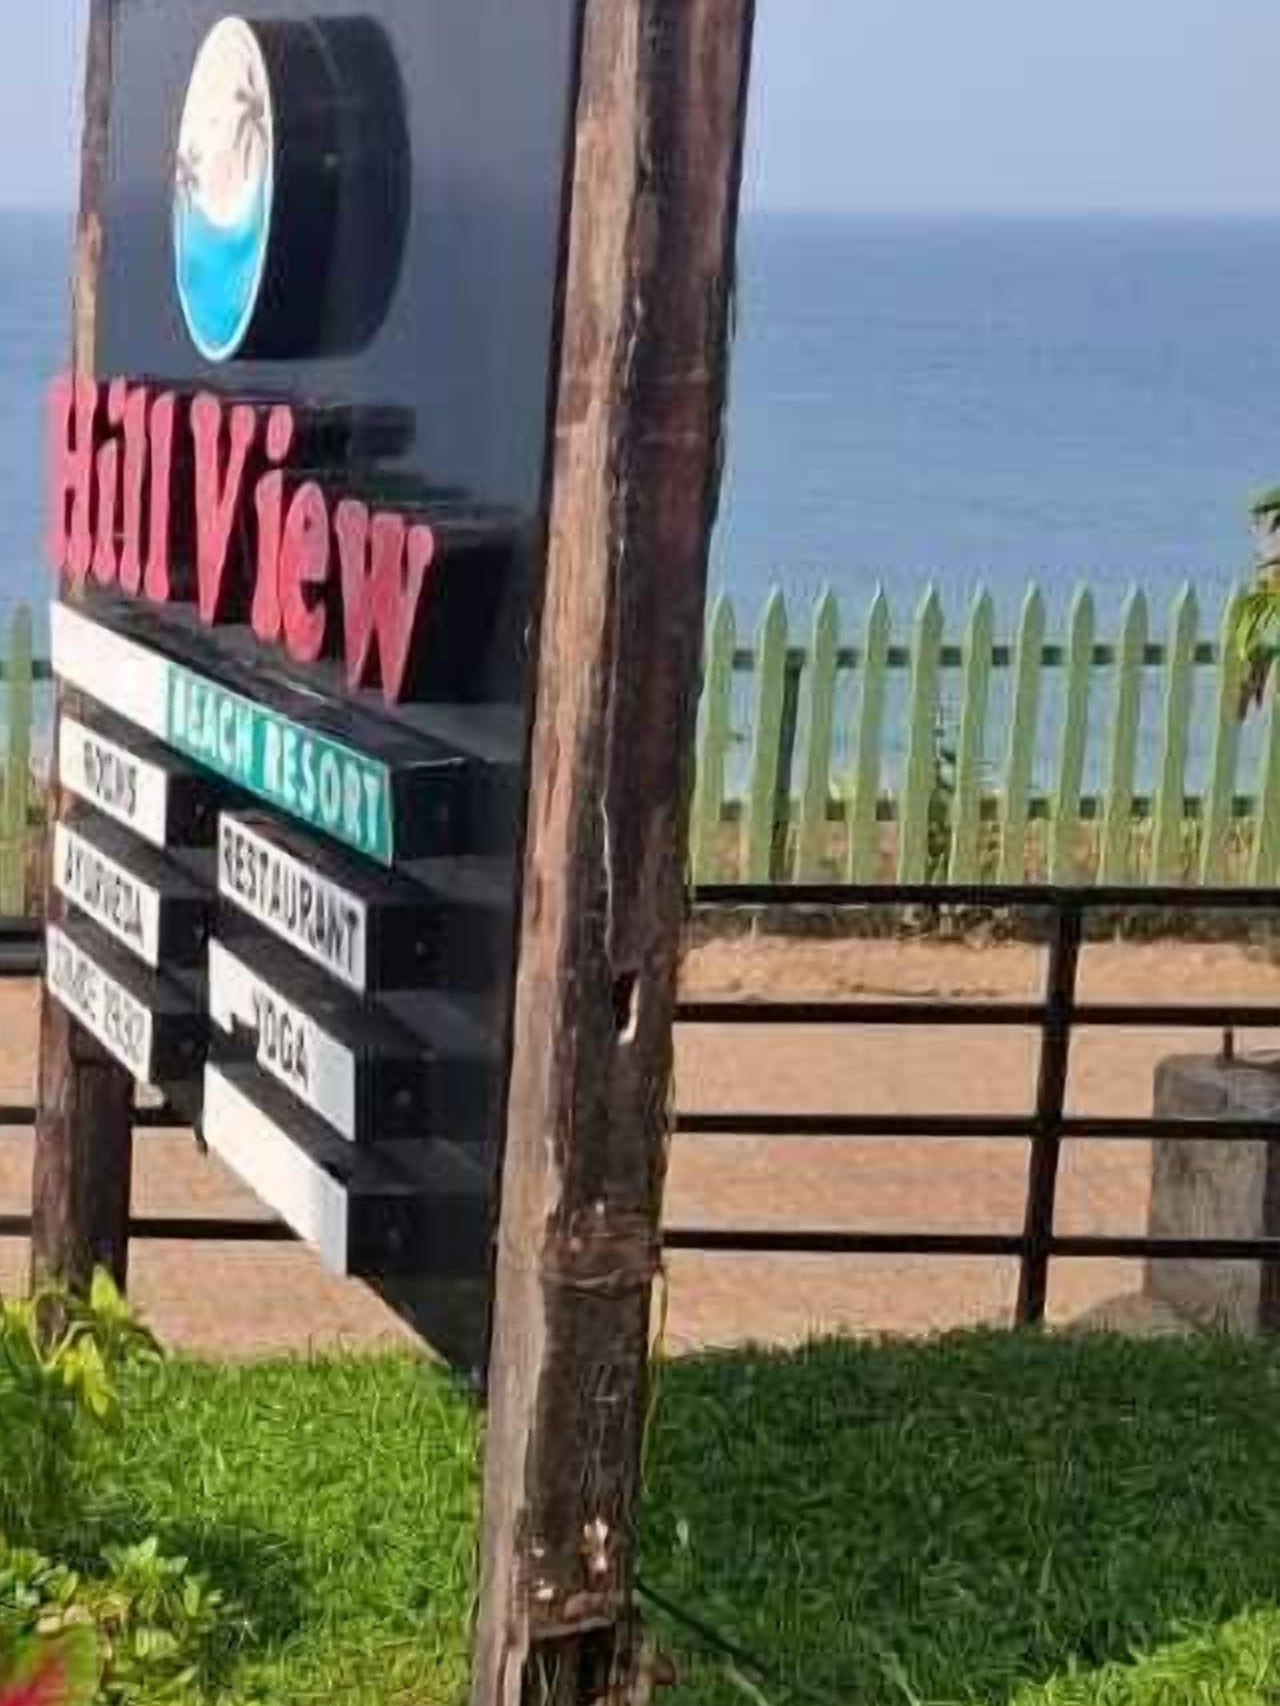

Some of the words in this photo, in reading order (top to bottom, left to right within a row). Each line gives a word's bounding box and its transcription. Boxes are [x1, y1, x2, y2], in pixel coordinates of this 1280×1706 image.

[46, 374, 176, 601] Hill
[191, 391, 434, 711] View
[263, 721, 382, 851] RESORT
[222, 823, 358, 973] RESTAURANT
[252, 983, 309, 1095] YOGA
